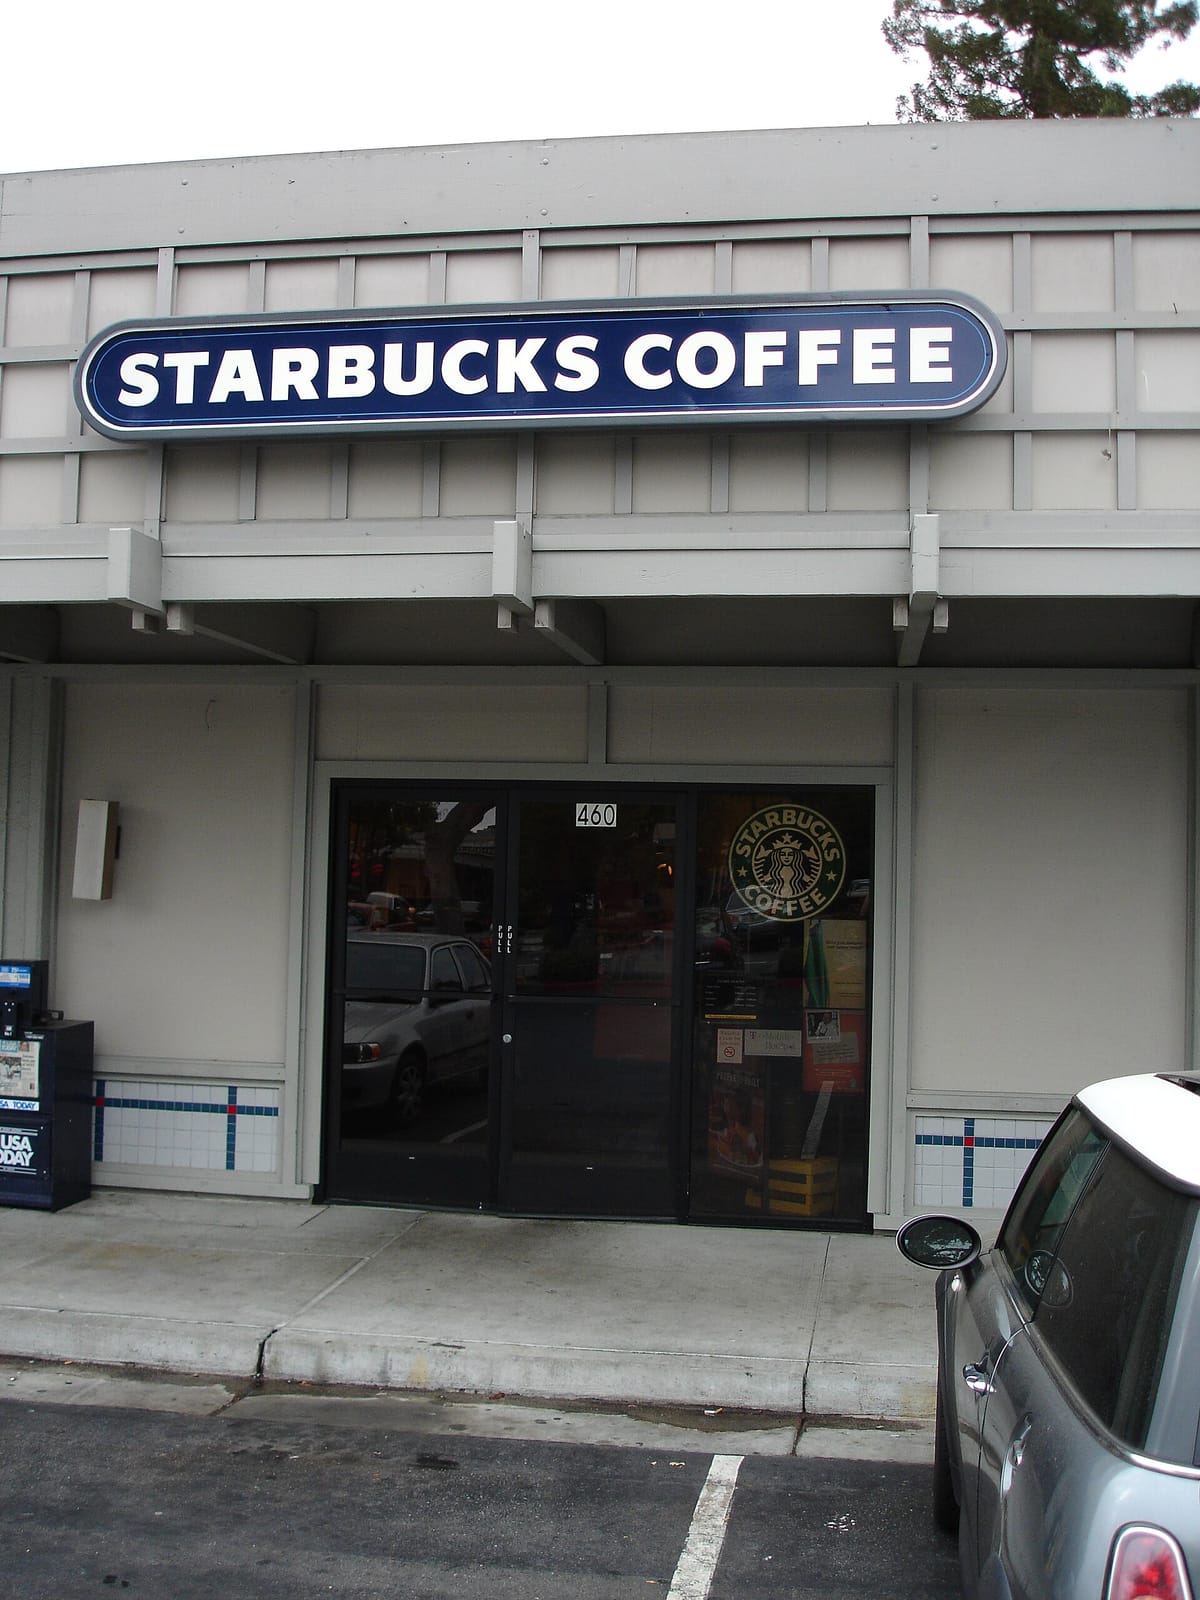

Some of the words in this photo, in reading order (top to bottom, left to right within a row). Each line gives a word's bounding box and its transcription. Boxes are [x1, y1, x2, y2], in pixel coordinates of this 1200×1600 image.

[117, 334, 601, 408] STARBUCKS
[622, 326, 955, 392] COFFEE
[577, 804, 615, 826] 460
[735, 808, 841, 863] STARBUCKS
[744, 884, 827, 917] COFFEE
[13, 1100, 36, 1109] TODAY
[0, 1134, 32, 1151] USA
